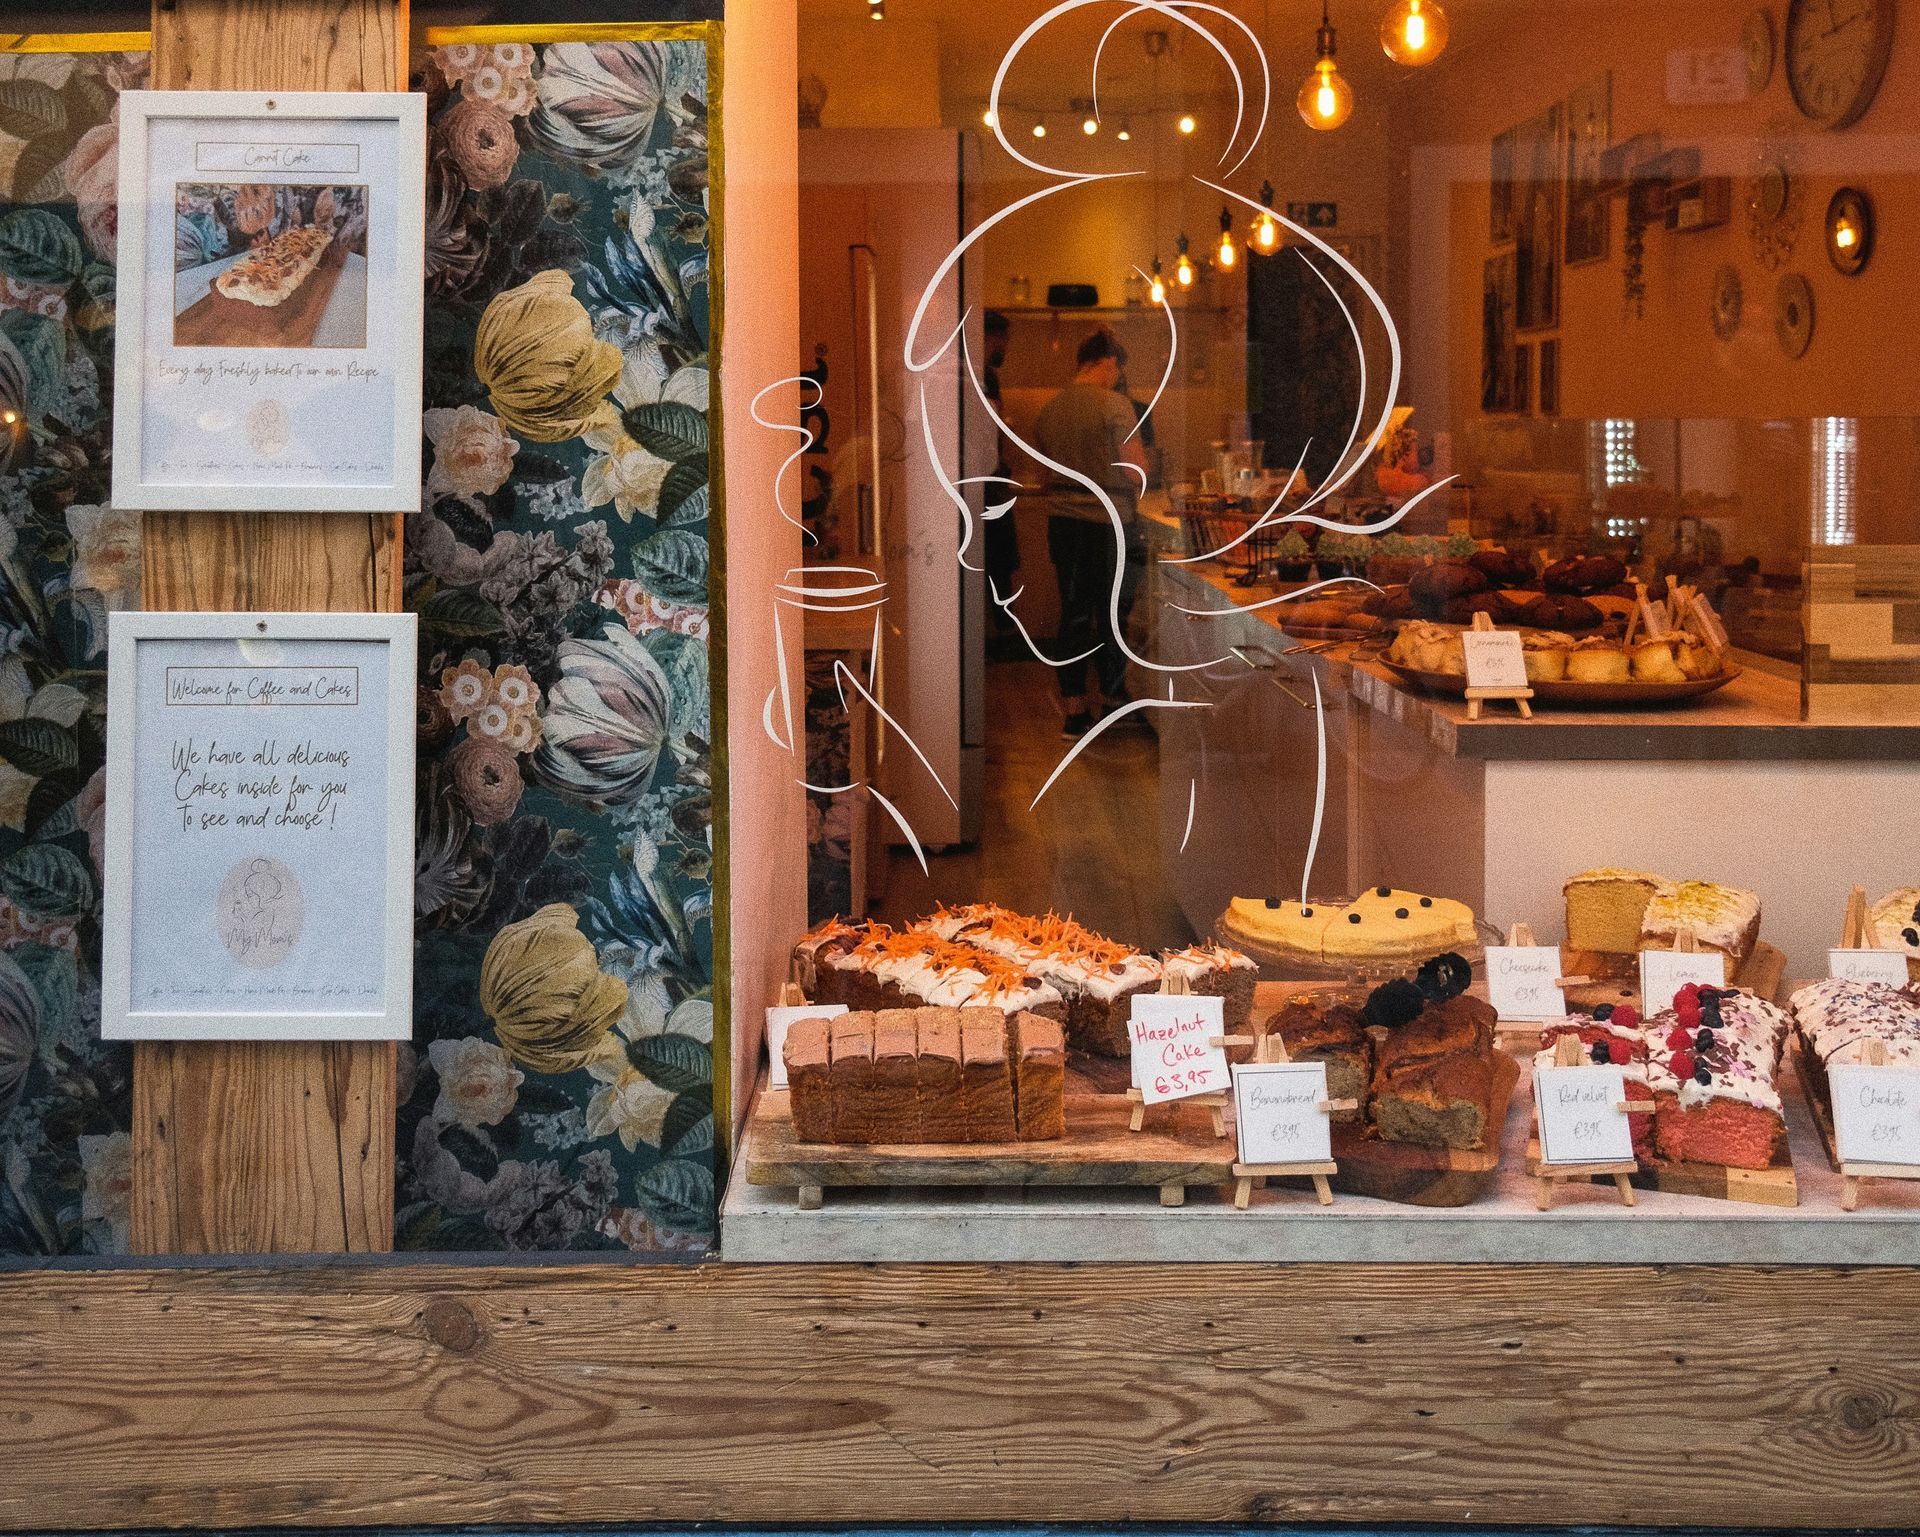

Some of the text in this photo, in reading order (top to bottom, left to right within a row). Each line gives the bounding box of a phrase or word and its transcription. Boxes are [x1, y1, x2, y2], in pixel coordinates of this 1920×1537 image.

[283, 147, 310, 166] Cake
[159, 360, 189, 384] Every
[194, 363, 213, 384] day
[219, 361, 260, 385] Freshly
[264, 362, 292, 377] baked
[347, 361, 379, 382] Recipe
[172, 676, 351, 704] Welcome for Coffee and Cakes
[172, 738, 350, 771] We have all delicious
[175, 769, 347, 813] Cakes inside for you
[177, 803, 193, 832] To
[201, 812, 229, 830] see
[236, 806, 270, 828] and
[1135, 1013, 1206, 1045] Hazelnut
[1162, 1043, 1207, 1067] Cake
[1155, 1070, 1213, 1094] €3,95
[1250, 1086, 1316, 1110] Bananabread
[1558, 1084, 1609, 1107] Red velvet
[1860, 1085, 1907, 1108] Chocolate
